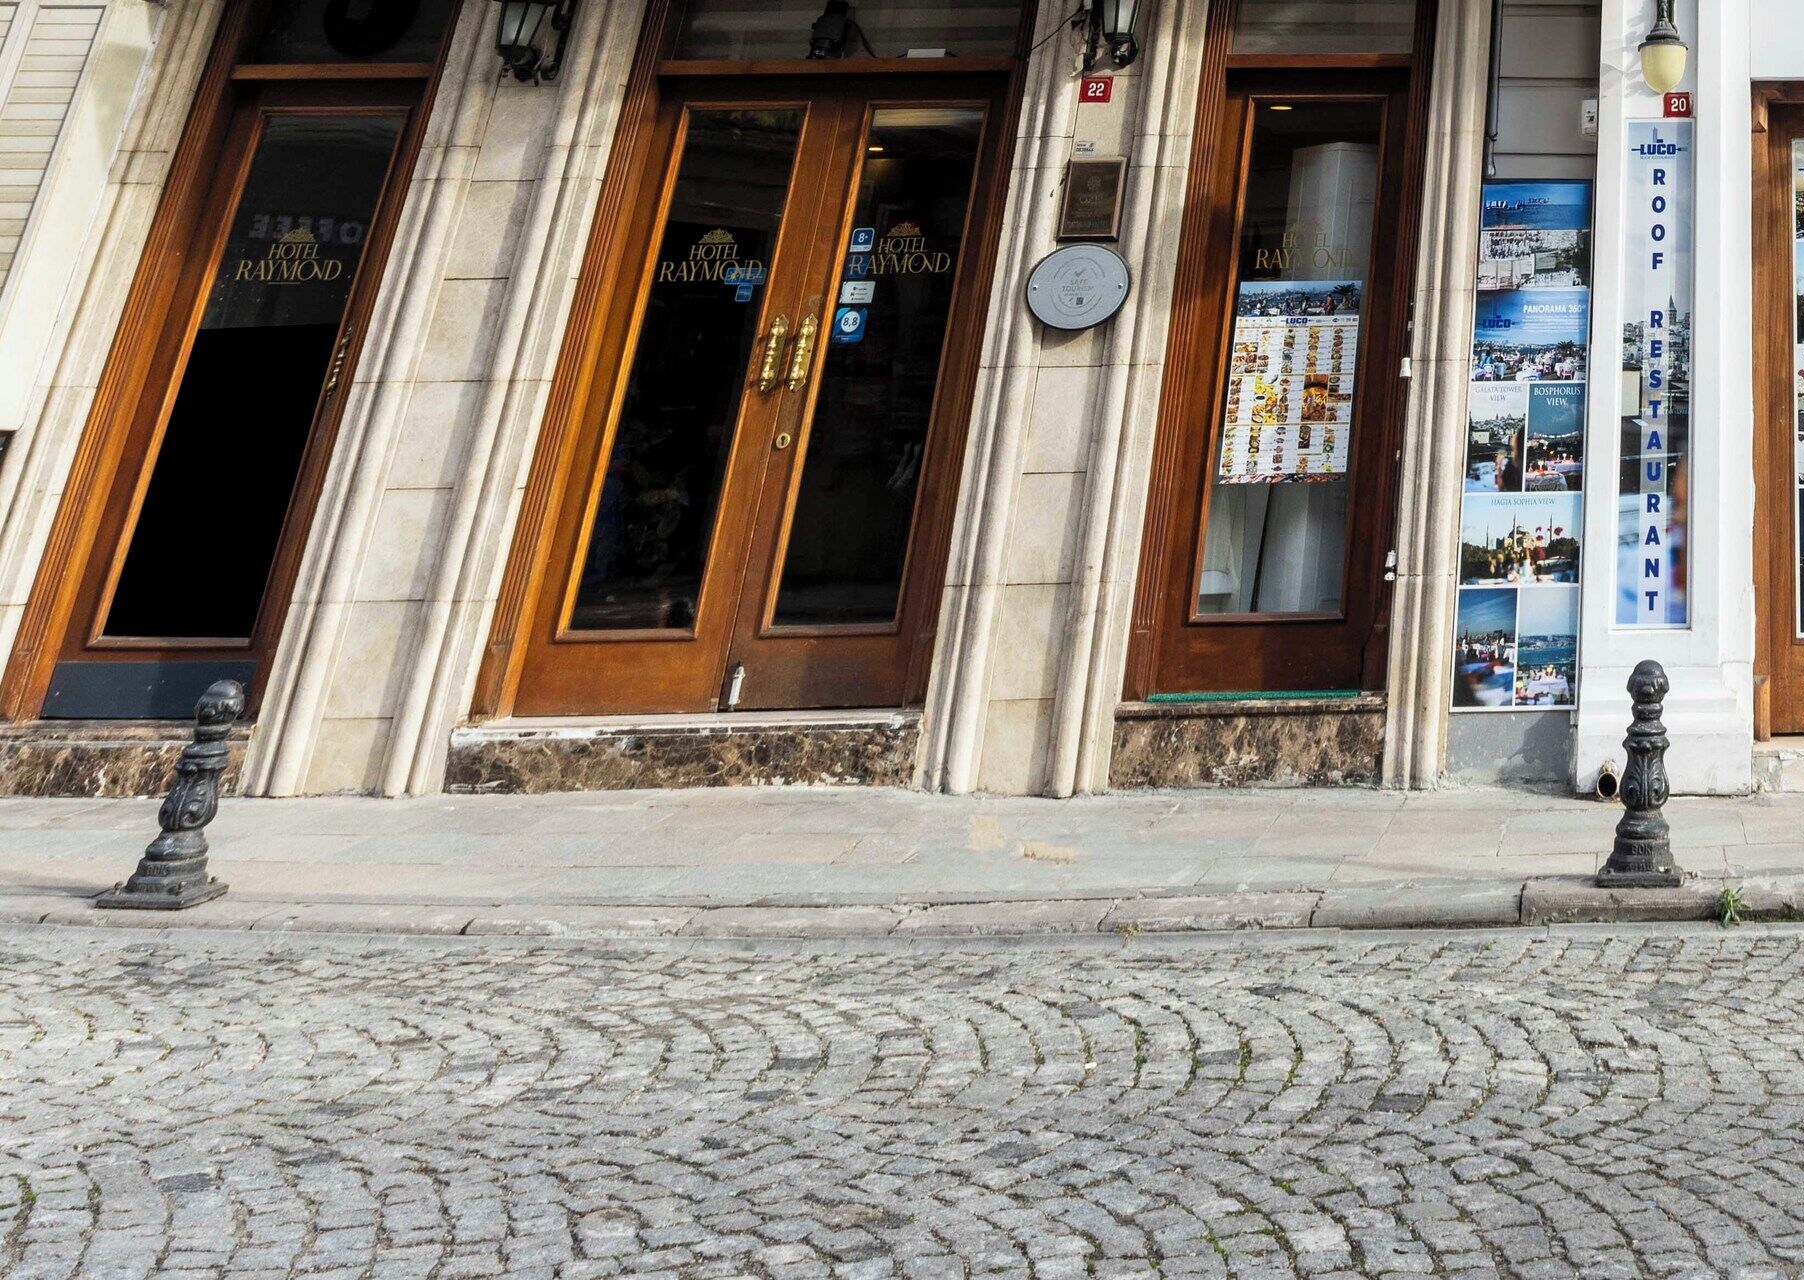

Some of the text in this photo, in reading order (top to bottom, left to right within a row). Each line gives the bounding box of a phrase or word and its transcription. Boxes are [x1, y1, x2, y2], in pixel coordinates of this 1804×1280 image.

[1088, 83, 1105, 97] 22
[1671, 98, 1687, 112] 20
[1640, 143, 1677, 155] LUCO
[268, 243, 320, 259] HOTEL
[689, 244, 740, 260] HOTEL
[878, 237, 929, 253] HOTEL
[235, 259, 342, 281] RAYMOND
[658, 259, 763, 282] RAYMOND
[849, 252, 951, 275] RAYMOND
[1523, 305, 1567, 314] PANORAMA
[1534, 386, 1581, 396] BOSPHORUS
[1645, 168, 1666, 611] ROOF RESTAURANT
[1546, 397, 1568, 406] VIEW
